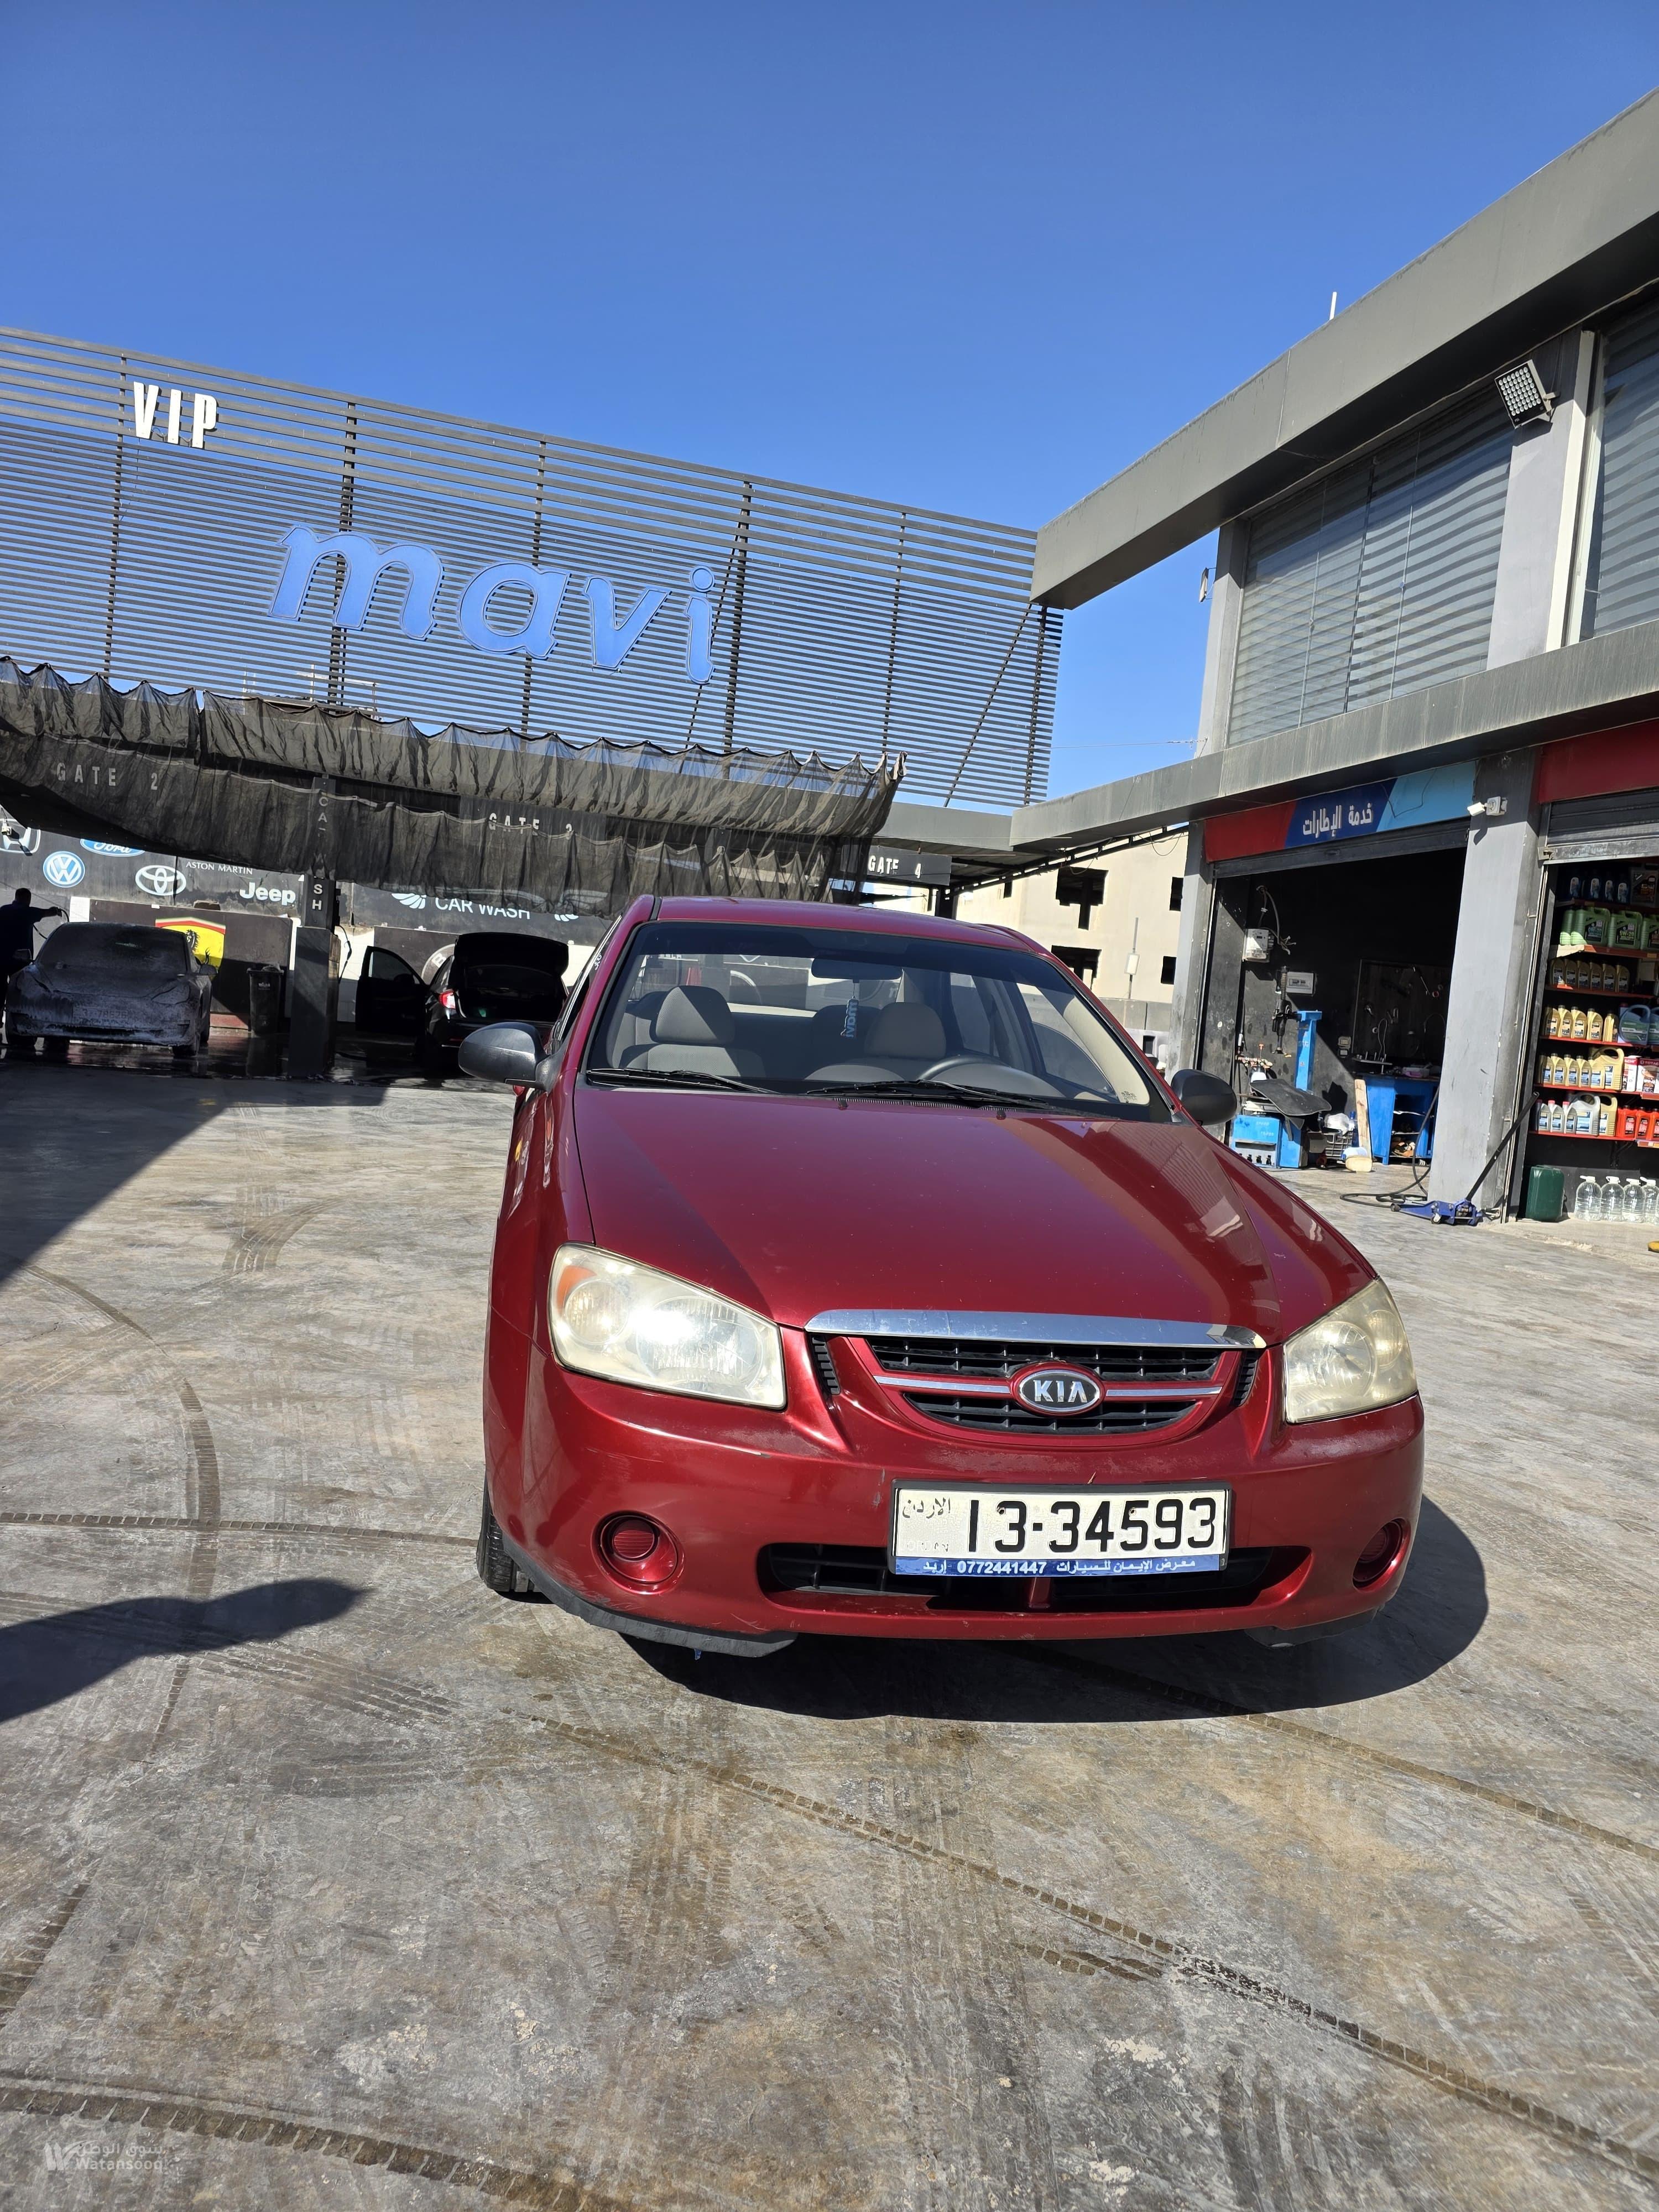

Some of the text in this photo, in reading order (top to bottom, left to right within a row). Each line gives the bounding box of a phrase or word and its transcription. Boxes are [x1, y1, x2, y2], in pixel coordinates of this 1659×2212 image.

[133, 382, 218, 448] VIP
[268, 525, 716, 685] mavi
[57, 763, 158, 790] GATE 2
[488, 813, 540, 836] GATE
[1303, 803, 1373, 838] خدمة الإطارات
[186, 862, 253, 875] ASTON MARTIN
[868, 855, 921, 879] GATE 4
[239, 882, 296, 906] Jeep
[435, 897, 473, 914] CAR
[1033, 1380, 1088, 1403] KIA
[968, 1497, 1216, 1553] 13-34593
[923, 1558, 1196, 1575] معرض الإيمان للسيارات 0772441447 إربد
